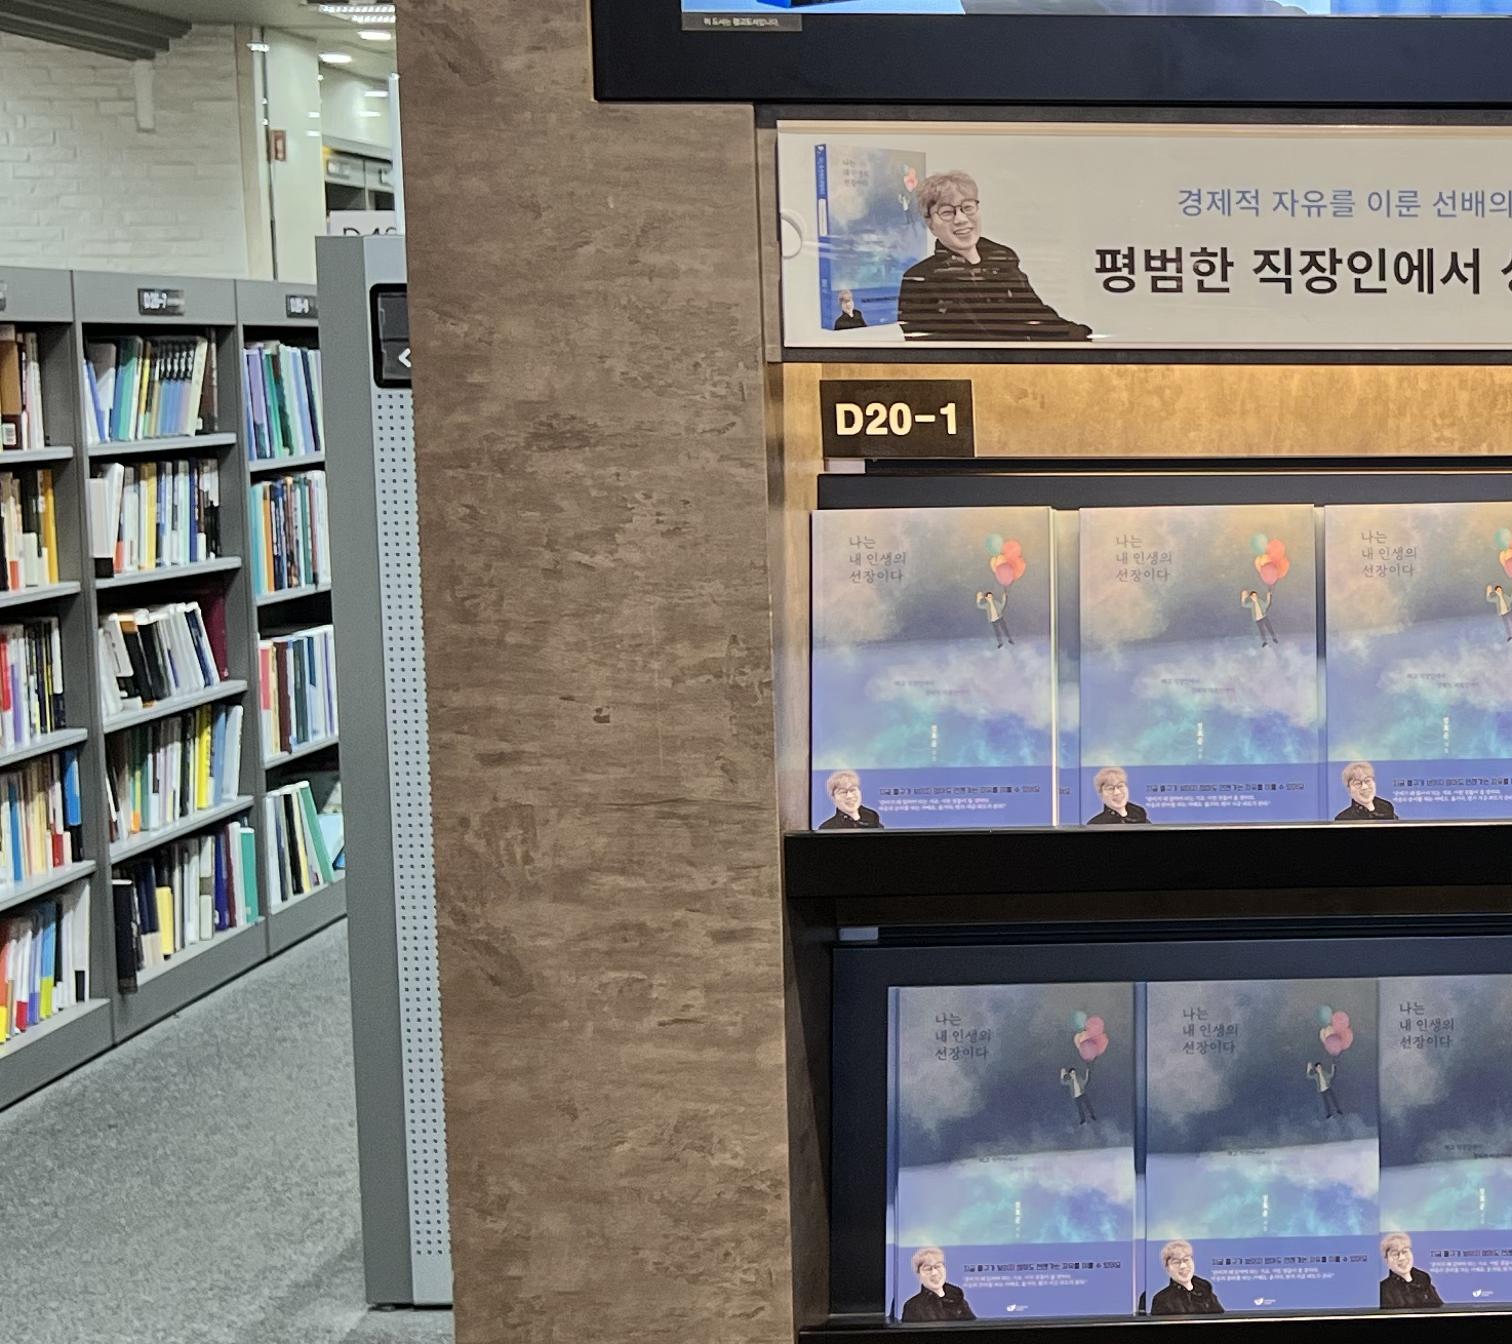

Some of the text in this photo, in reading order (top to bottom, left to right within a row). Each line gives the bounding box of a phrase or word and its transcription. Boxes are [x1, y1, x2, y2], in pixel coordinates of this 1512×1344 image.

[1179, 189, 1259, 217] 경제적
[1273, 189, 1355, 217] 자유를
[1368, 190, 1421, 218] 이룬
[1433, 190, 1512, 218] 선배의
[1095, 247, 1234, 293] 평범한
[1253, 248, 1479, 294] 직장인에서
[836, 403, 956, 435] D20-1
[850, 536, 876, 549] 나는
[1361, 530, 1387, 544] 나는
[850, 552, 905, 567] 내 인생의
[1362, 546, 1416, 561] 내 인생의
[849, 568, 903, 584] 선장이다
[1361, 563, 1414, 578] 선장이다
[1400, 1002, 1424, 1015] 나는
[936, 1013, 961, 1026] 나는
[1400, 1018, 1454, 1033] 내 인생의
[936, 1028, 992, 1044] 내 인생의
[1400, 1034, 1452, 1050] 선장이다
[935, 1046, 989, 1061] 선장이다
